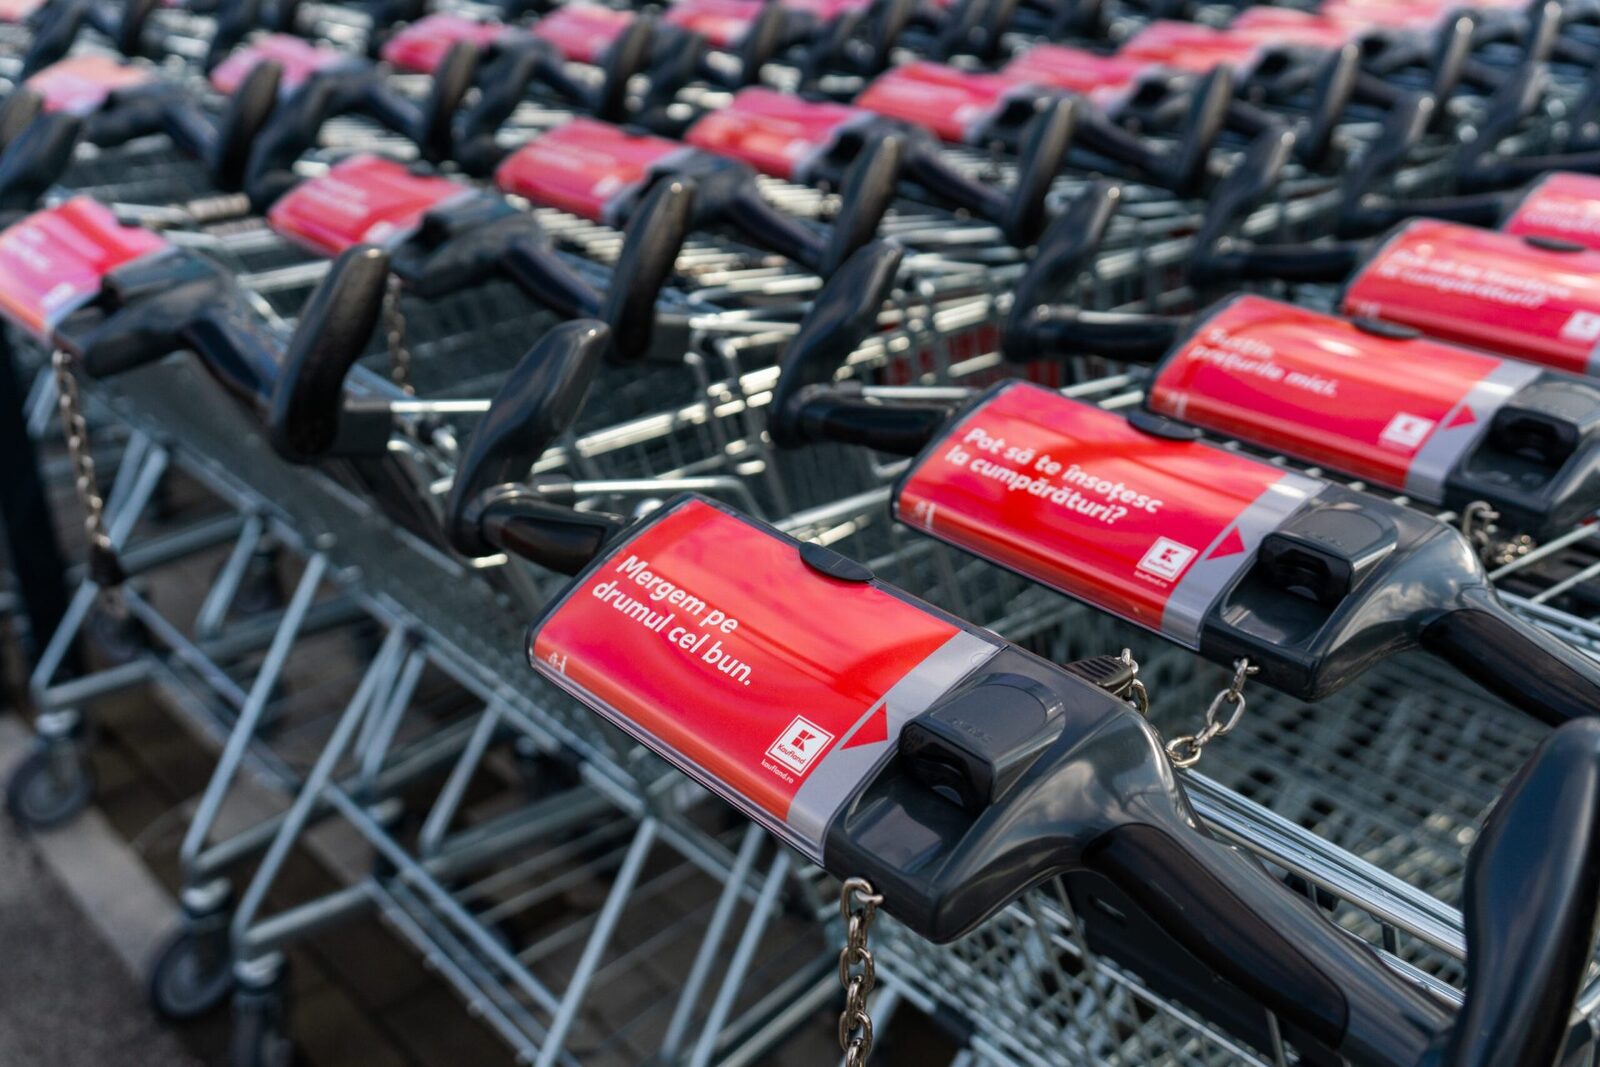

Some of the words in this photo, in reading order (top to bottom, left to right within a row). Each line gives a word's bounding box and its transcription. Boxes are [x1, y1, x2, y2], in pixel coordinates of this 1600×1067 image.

[945, 445, 970, 466] la
[970, 458, 1128, 524] cumpărături?
[963, 427, 1005, 454] Pot
[1004, 446, 1036, 465] să
[1034, 455, 1061, 475] te
[1062, 464, 1164, 513] însoțesc
[592, 580, 675, 632] drumul
[668, 626, 710, 653] cel
[702, 641, 751, 686] bun.
[616, 555, 706, 615] Mergem
[699, 609, 739, 634] pe
[761, 759, 794, 784] kaufland.ro
[777, 744, 806, 764] Kaufland
